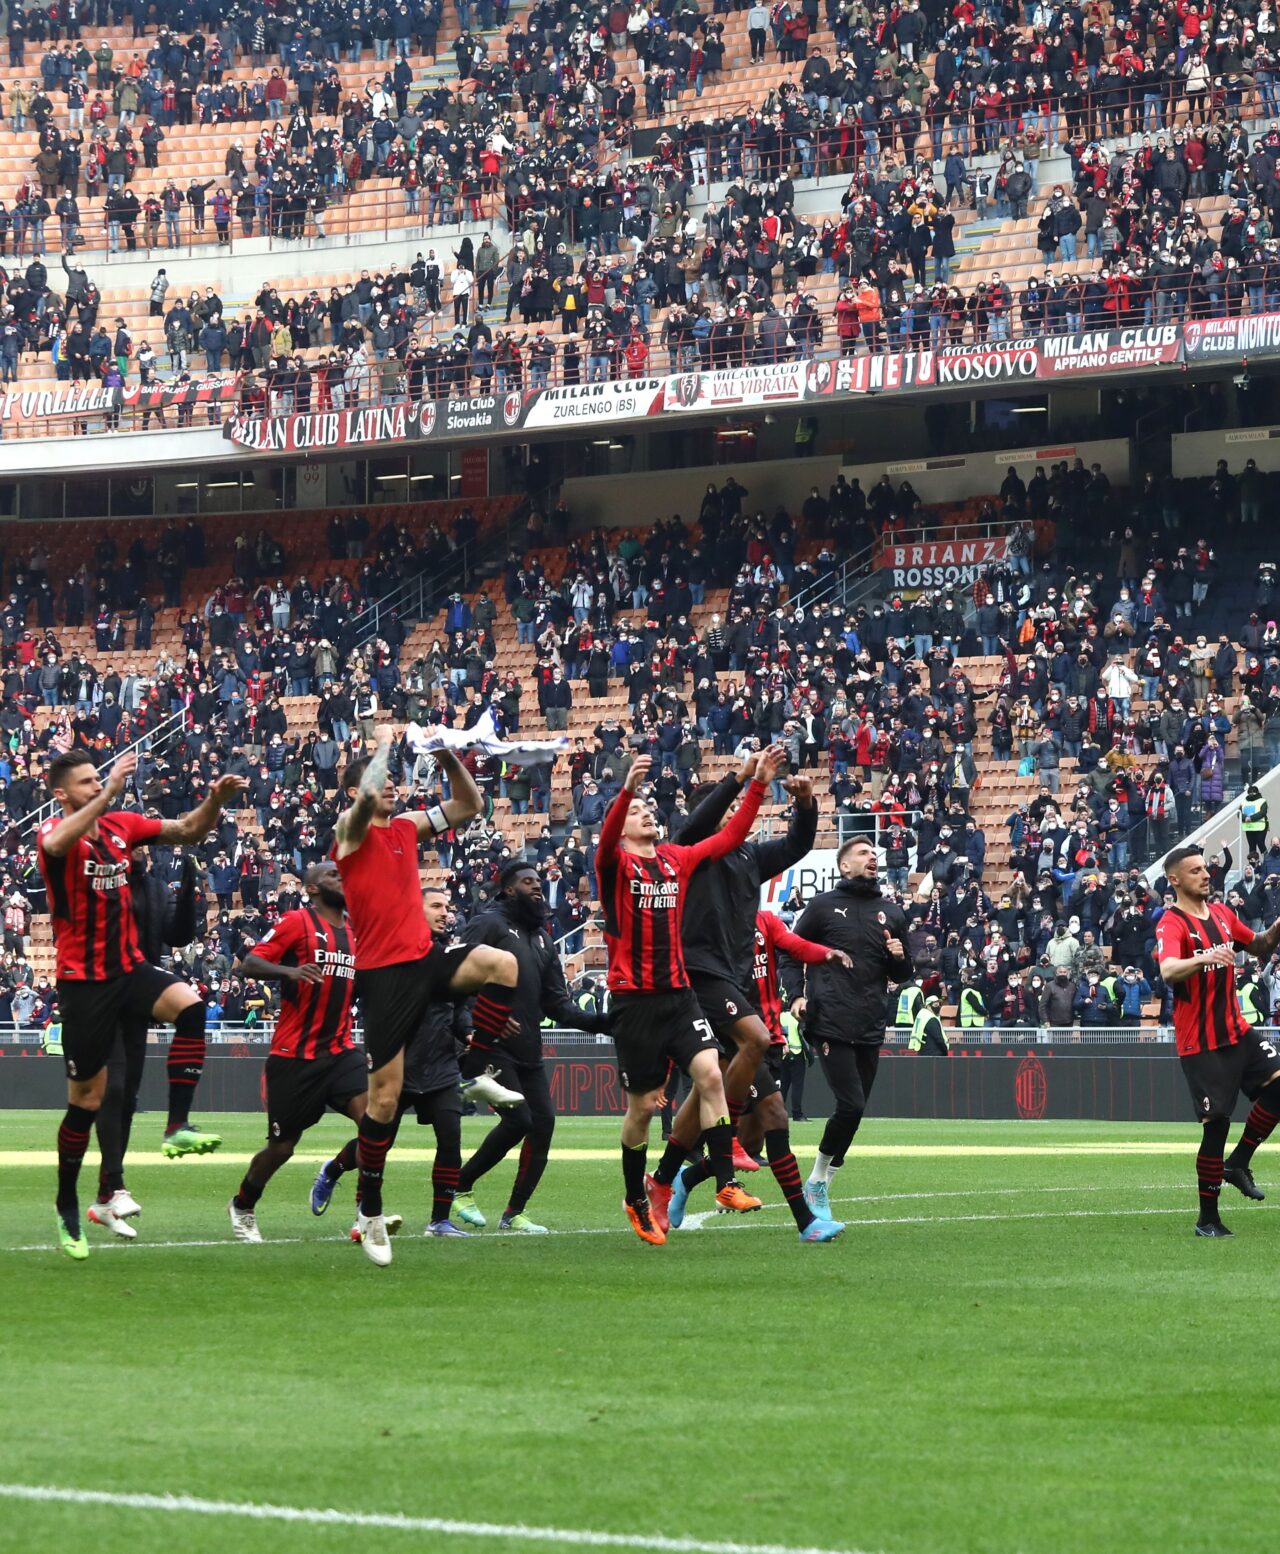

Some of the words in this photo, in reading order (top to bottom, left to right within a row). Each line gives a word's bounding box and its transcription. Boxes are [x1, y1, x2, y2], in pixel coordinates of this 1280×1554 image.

[1204, 319, 1236, 334] MILAN
[1043, 333, 1109, 358] MILAN
[1120, 325, 1177, 349] CLUB
[1202, 335, 1235, 351] CLUB
[938, 350, 1038, 383] KOSOVO
[1053, 352, 1108, 371] APPIANO
[1109, 348, 1163, 364] GENTILE
[141, 386, 158, 394] BAR
[196, 378, 235, 391] GIUSSANO
[544, 384, 604, 400] MILAN
[613, 378, 660, 394] CLUB
[713, 381, 736, 397] VAL
[741, 375, 799, 395] VIBRATA
[447, 400, 469, 413] Fan
[470, 398, 496, 411] Club
[553, 401, 612, 418] ZURLENGO
[615, 398, 636, 415] (BS)
[293, 412, 340, 448] CLUB
[345, 406, 407, 443] LATINA
[447, 412, 492, 430] Slovakia
[638, 896, 652, 909] FLY
[314, 949, 355, 966] Emirat
